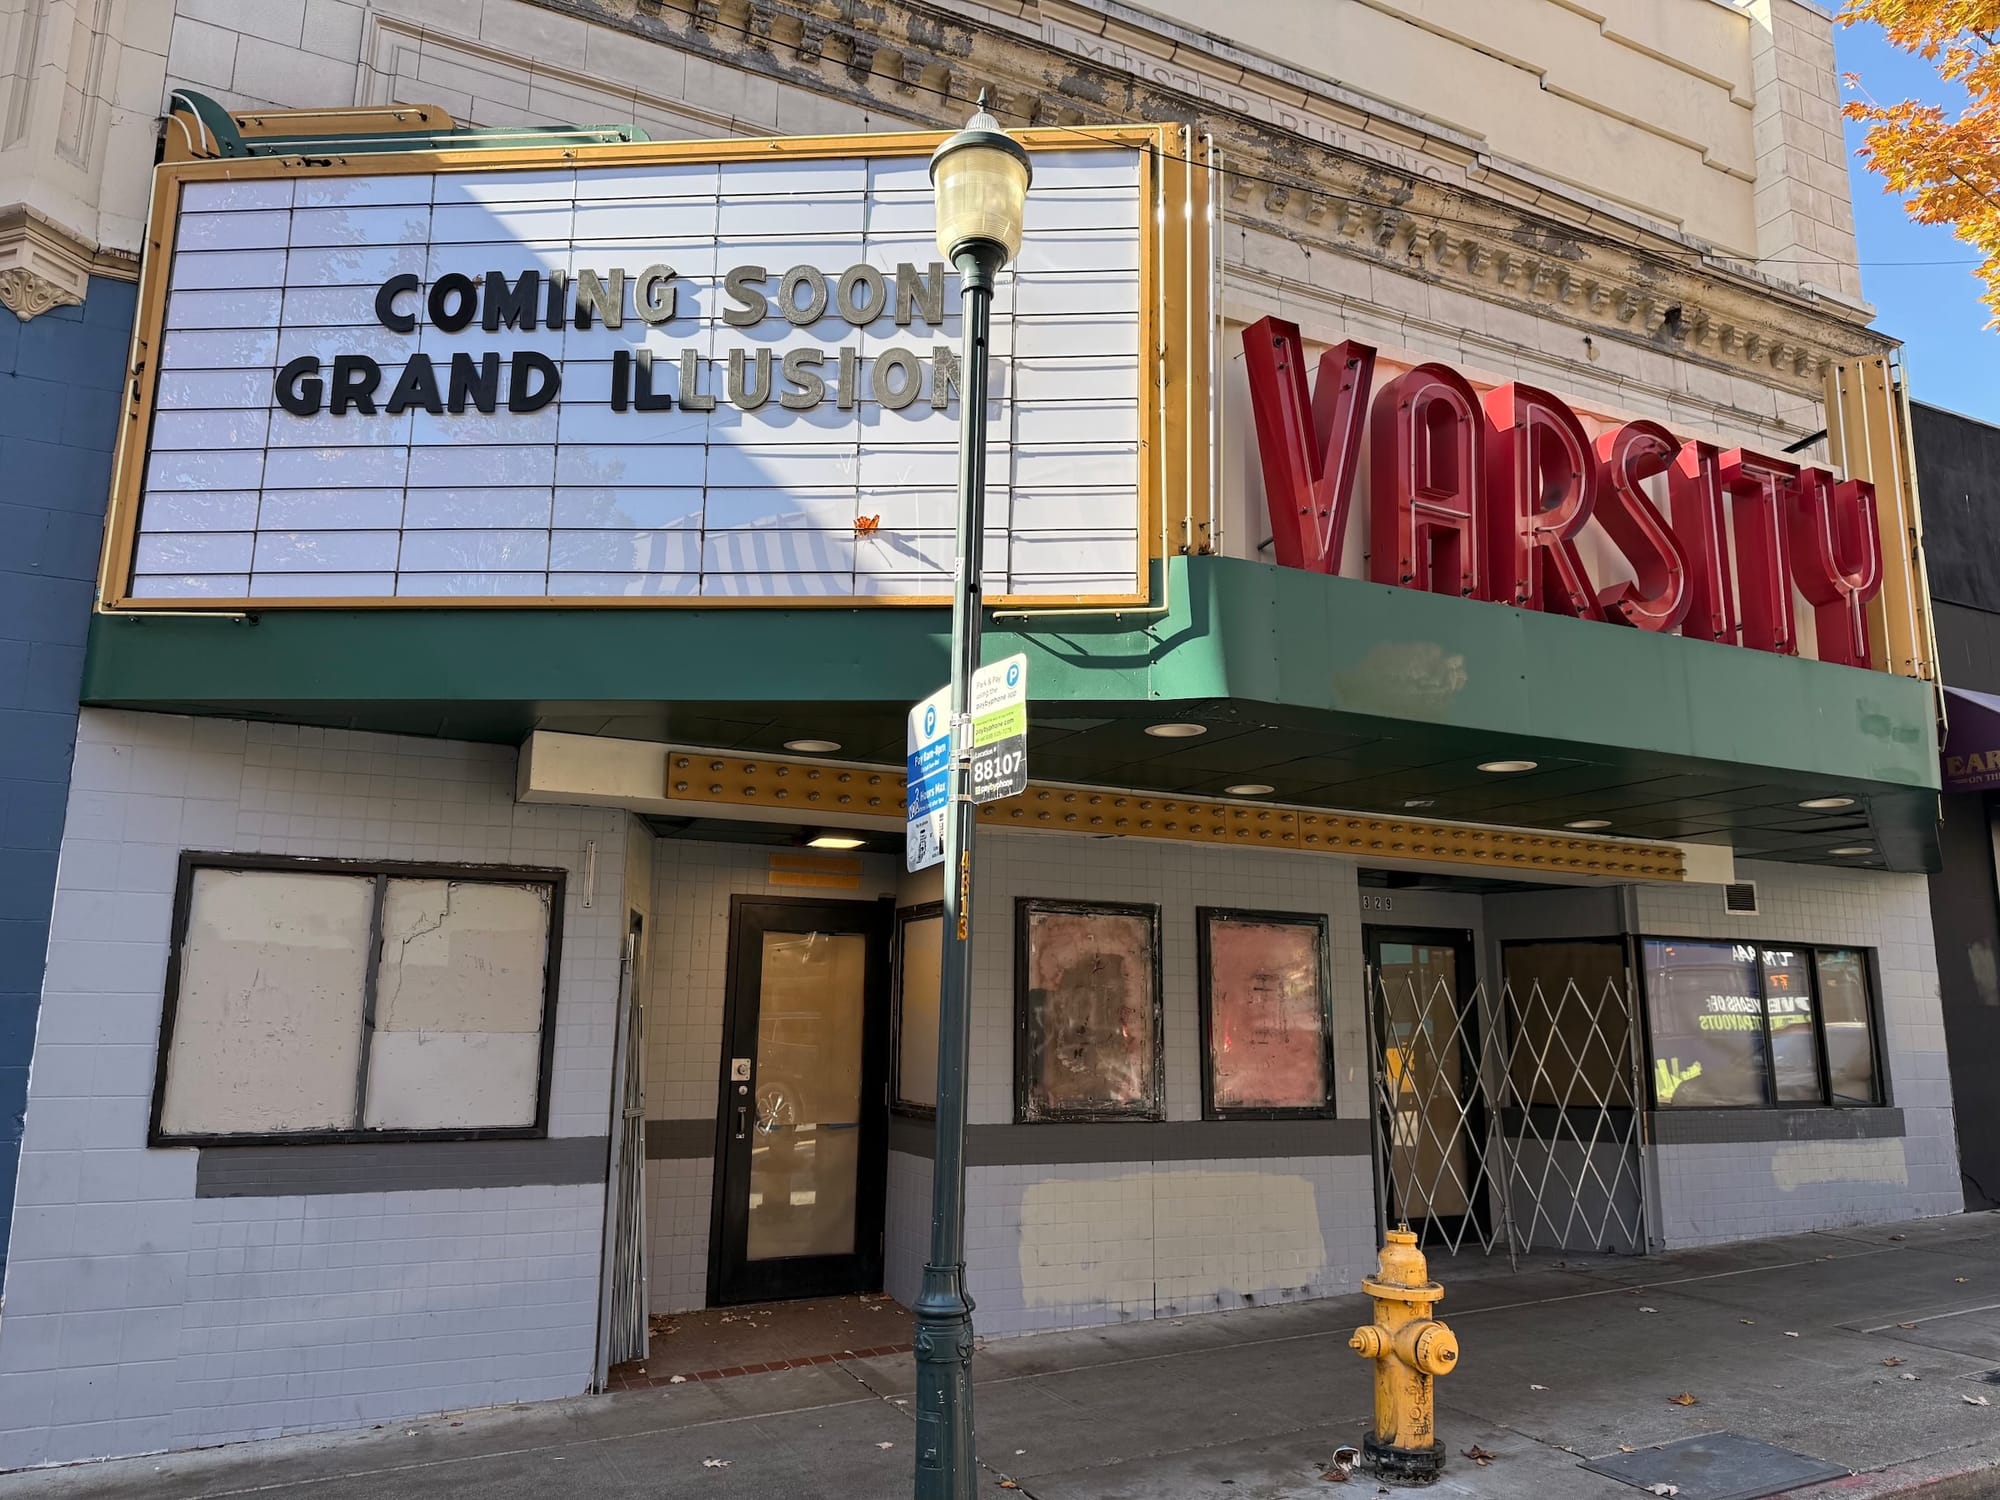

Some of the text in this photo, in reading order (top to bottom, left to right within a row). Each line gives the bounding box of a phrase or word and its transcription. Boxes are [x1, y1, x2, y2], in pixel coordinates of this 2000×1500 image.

[375, 261, 945, 333] COMING SOON
[274, 350, 561, 416] GRAND
[1242, 315, 1883, 670] VARSITY
[974, 750, 1022, 783] 88107
[1364, 896, 1391, 910] 329
